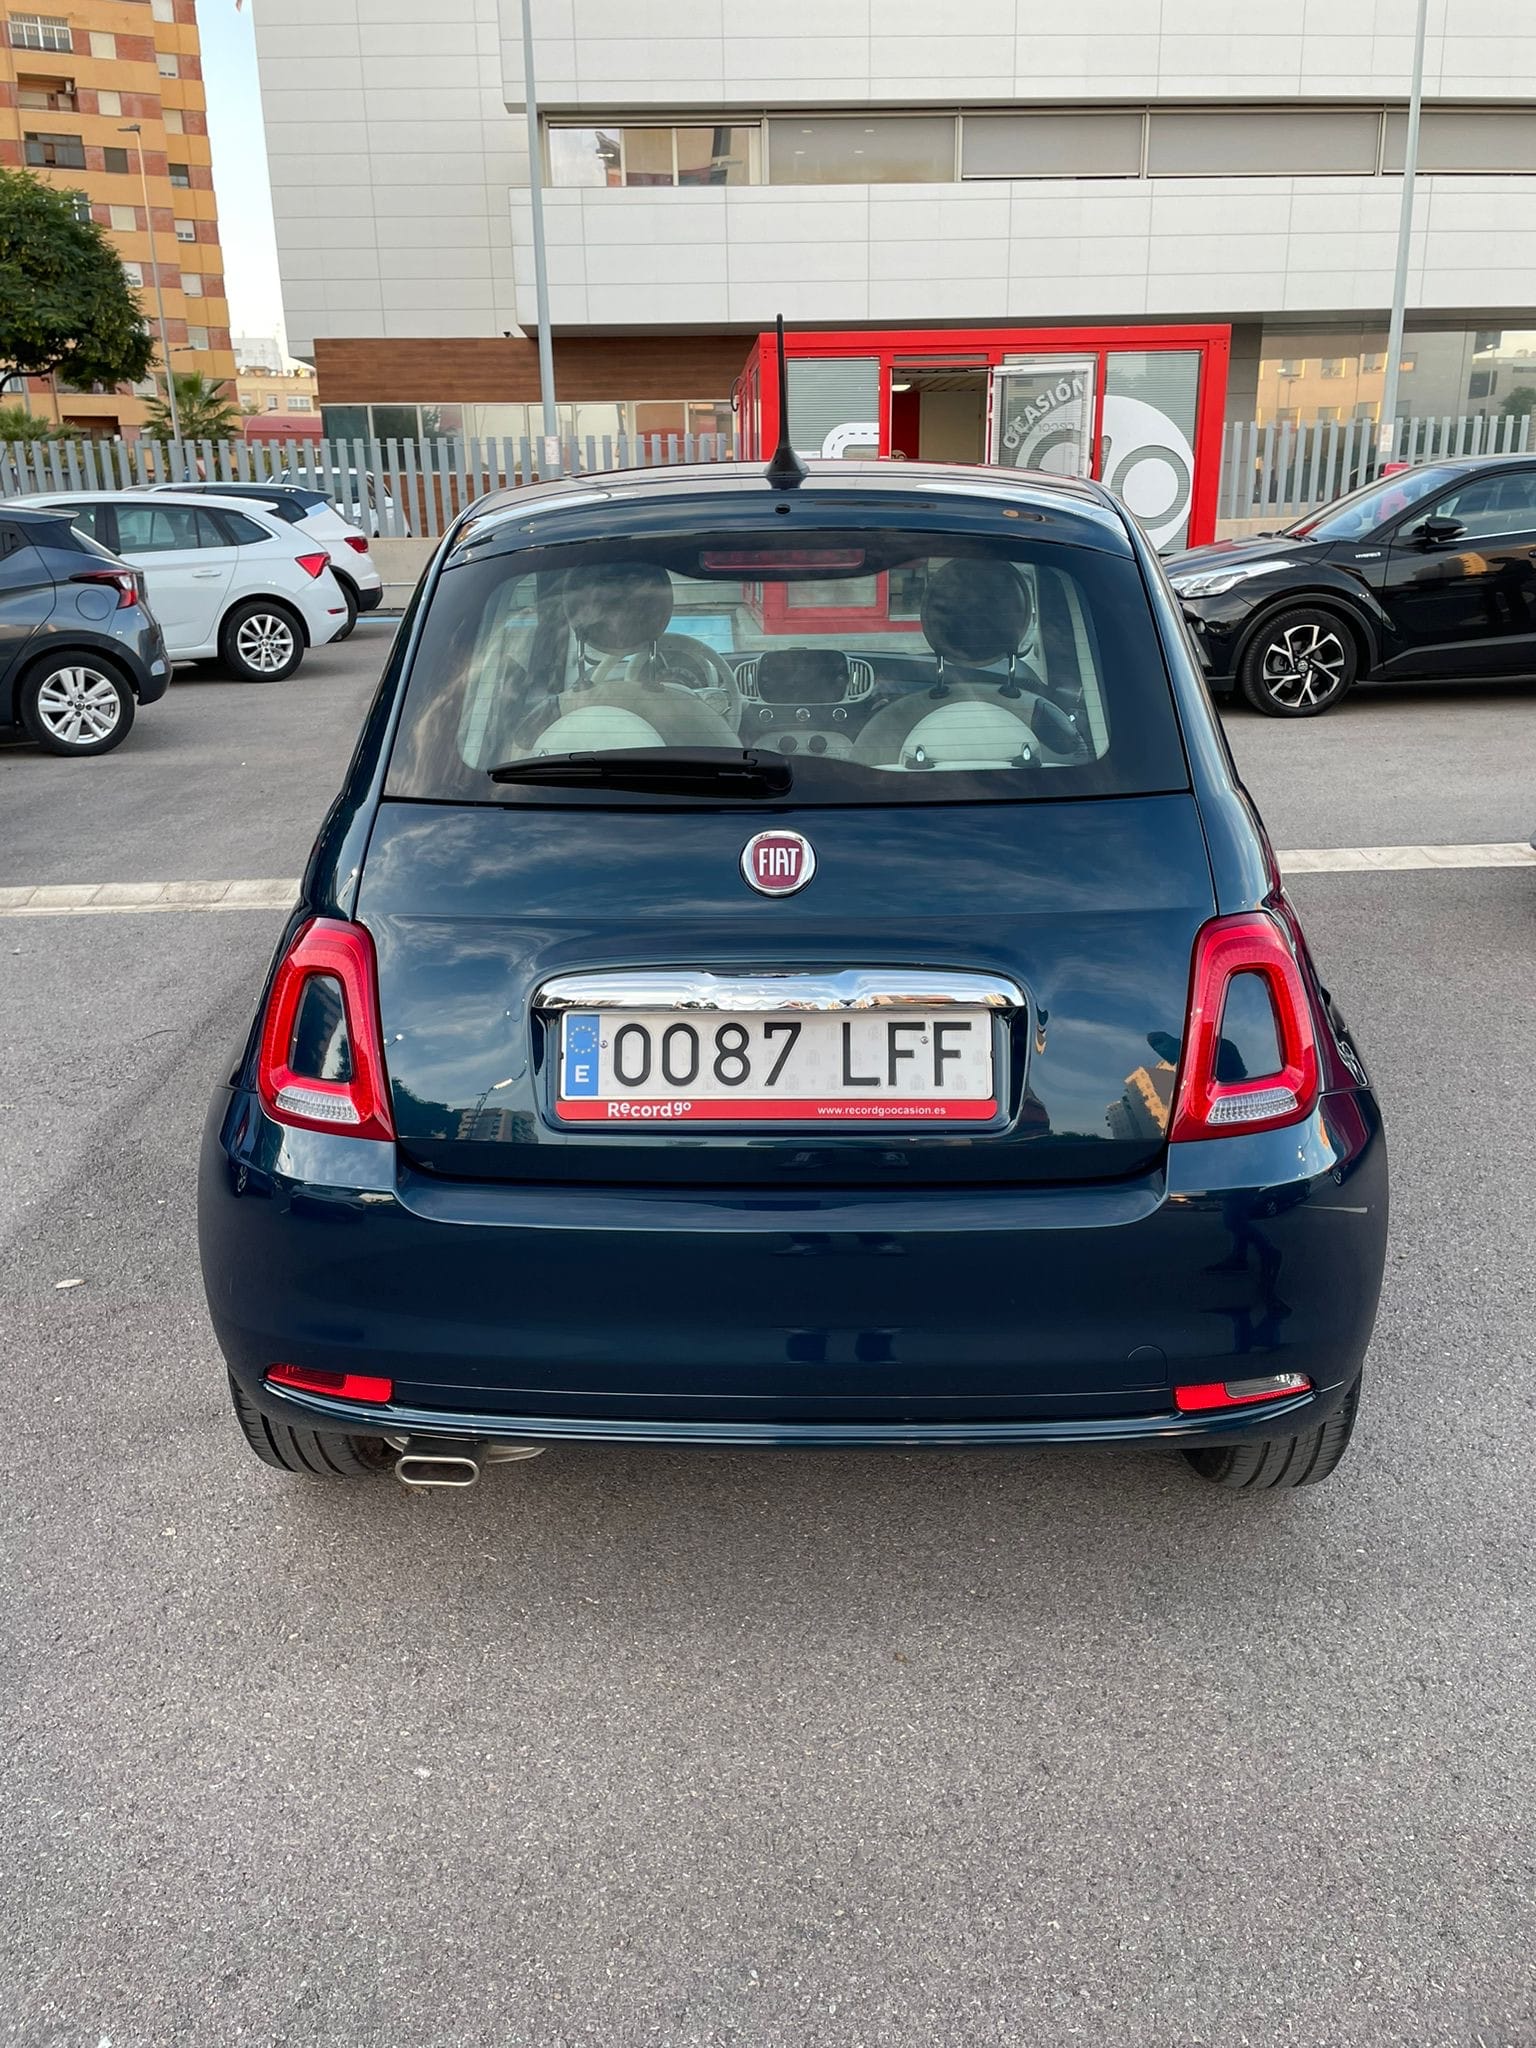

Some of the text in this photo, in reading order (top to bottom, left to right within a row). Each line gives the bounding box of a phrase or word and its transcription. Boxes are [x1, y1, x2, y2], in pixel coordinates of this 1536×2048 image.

[759, 847, 800, 876] FIAT
[613, 1021, 972, 1087] 0087 LFF
[575, 1064, 590, 1083] E
[817, 1105, 947, 1117] www.recordgoocasion.es
